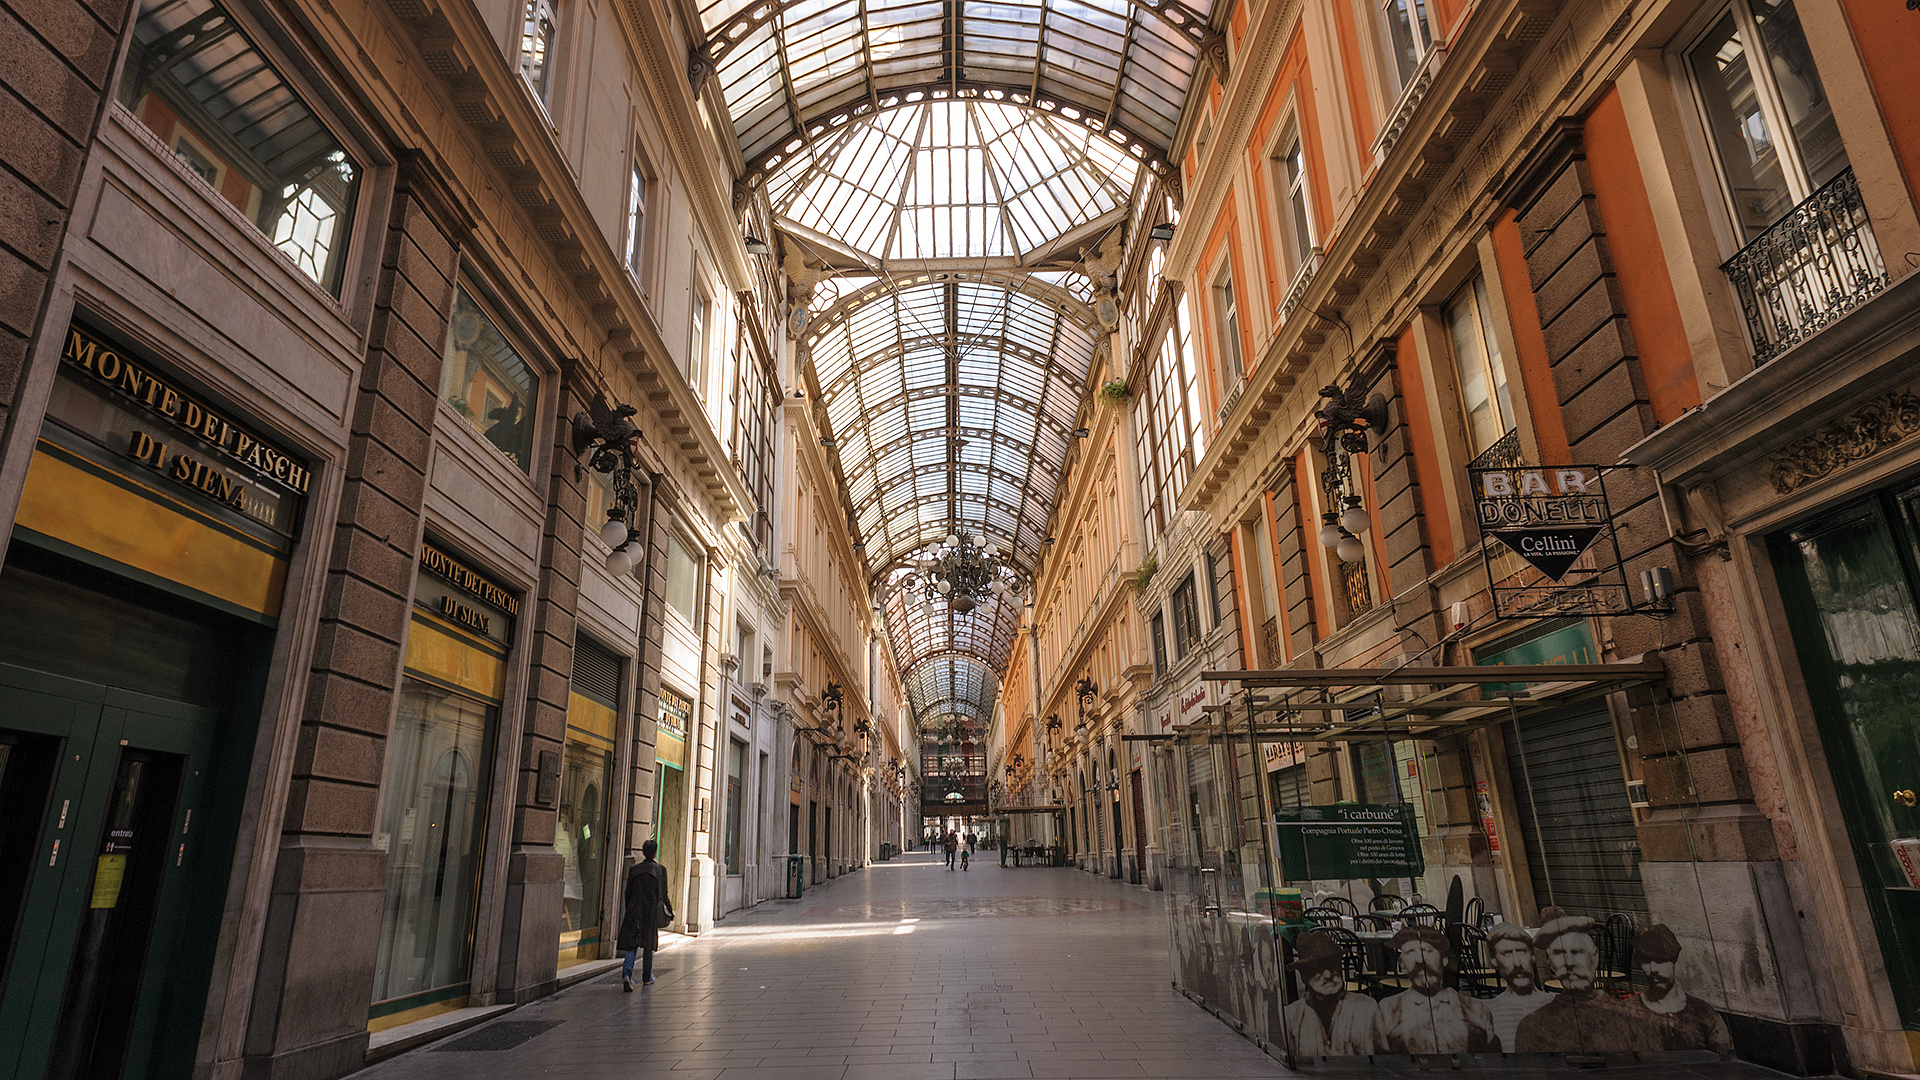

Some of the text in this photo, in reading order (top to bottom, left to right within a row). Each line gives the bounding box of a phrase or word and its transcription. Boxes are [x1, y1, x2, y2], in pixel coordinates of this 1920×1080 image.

[66, 331, 312, 493] MONTE DEI PASCHI
[135, 431, 246, 510] DI SIENA
[1482, 469, 1588, 496] BAR
[1479, 499, 1606, 525] DONELLI
[1520, 534, 1577, 552] Cellini
[421, 545, 519, 615] MONTE DEI PASCHI
[445, 597, 491, 634] DI SIENA
[1301, 827, 1402, 836] Compagnia Portuale Pietro Chiesa
